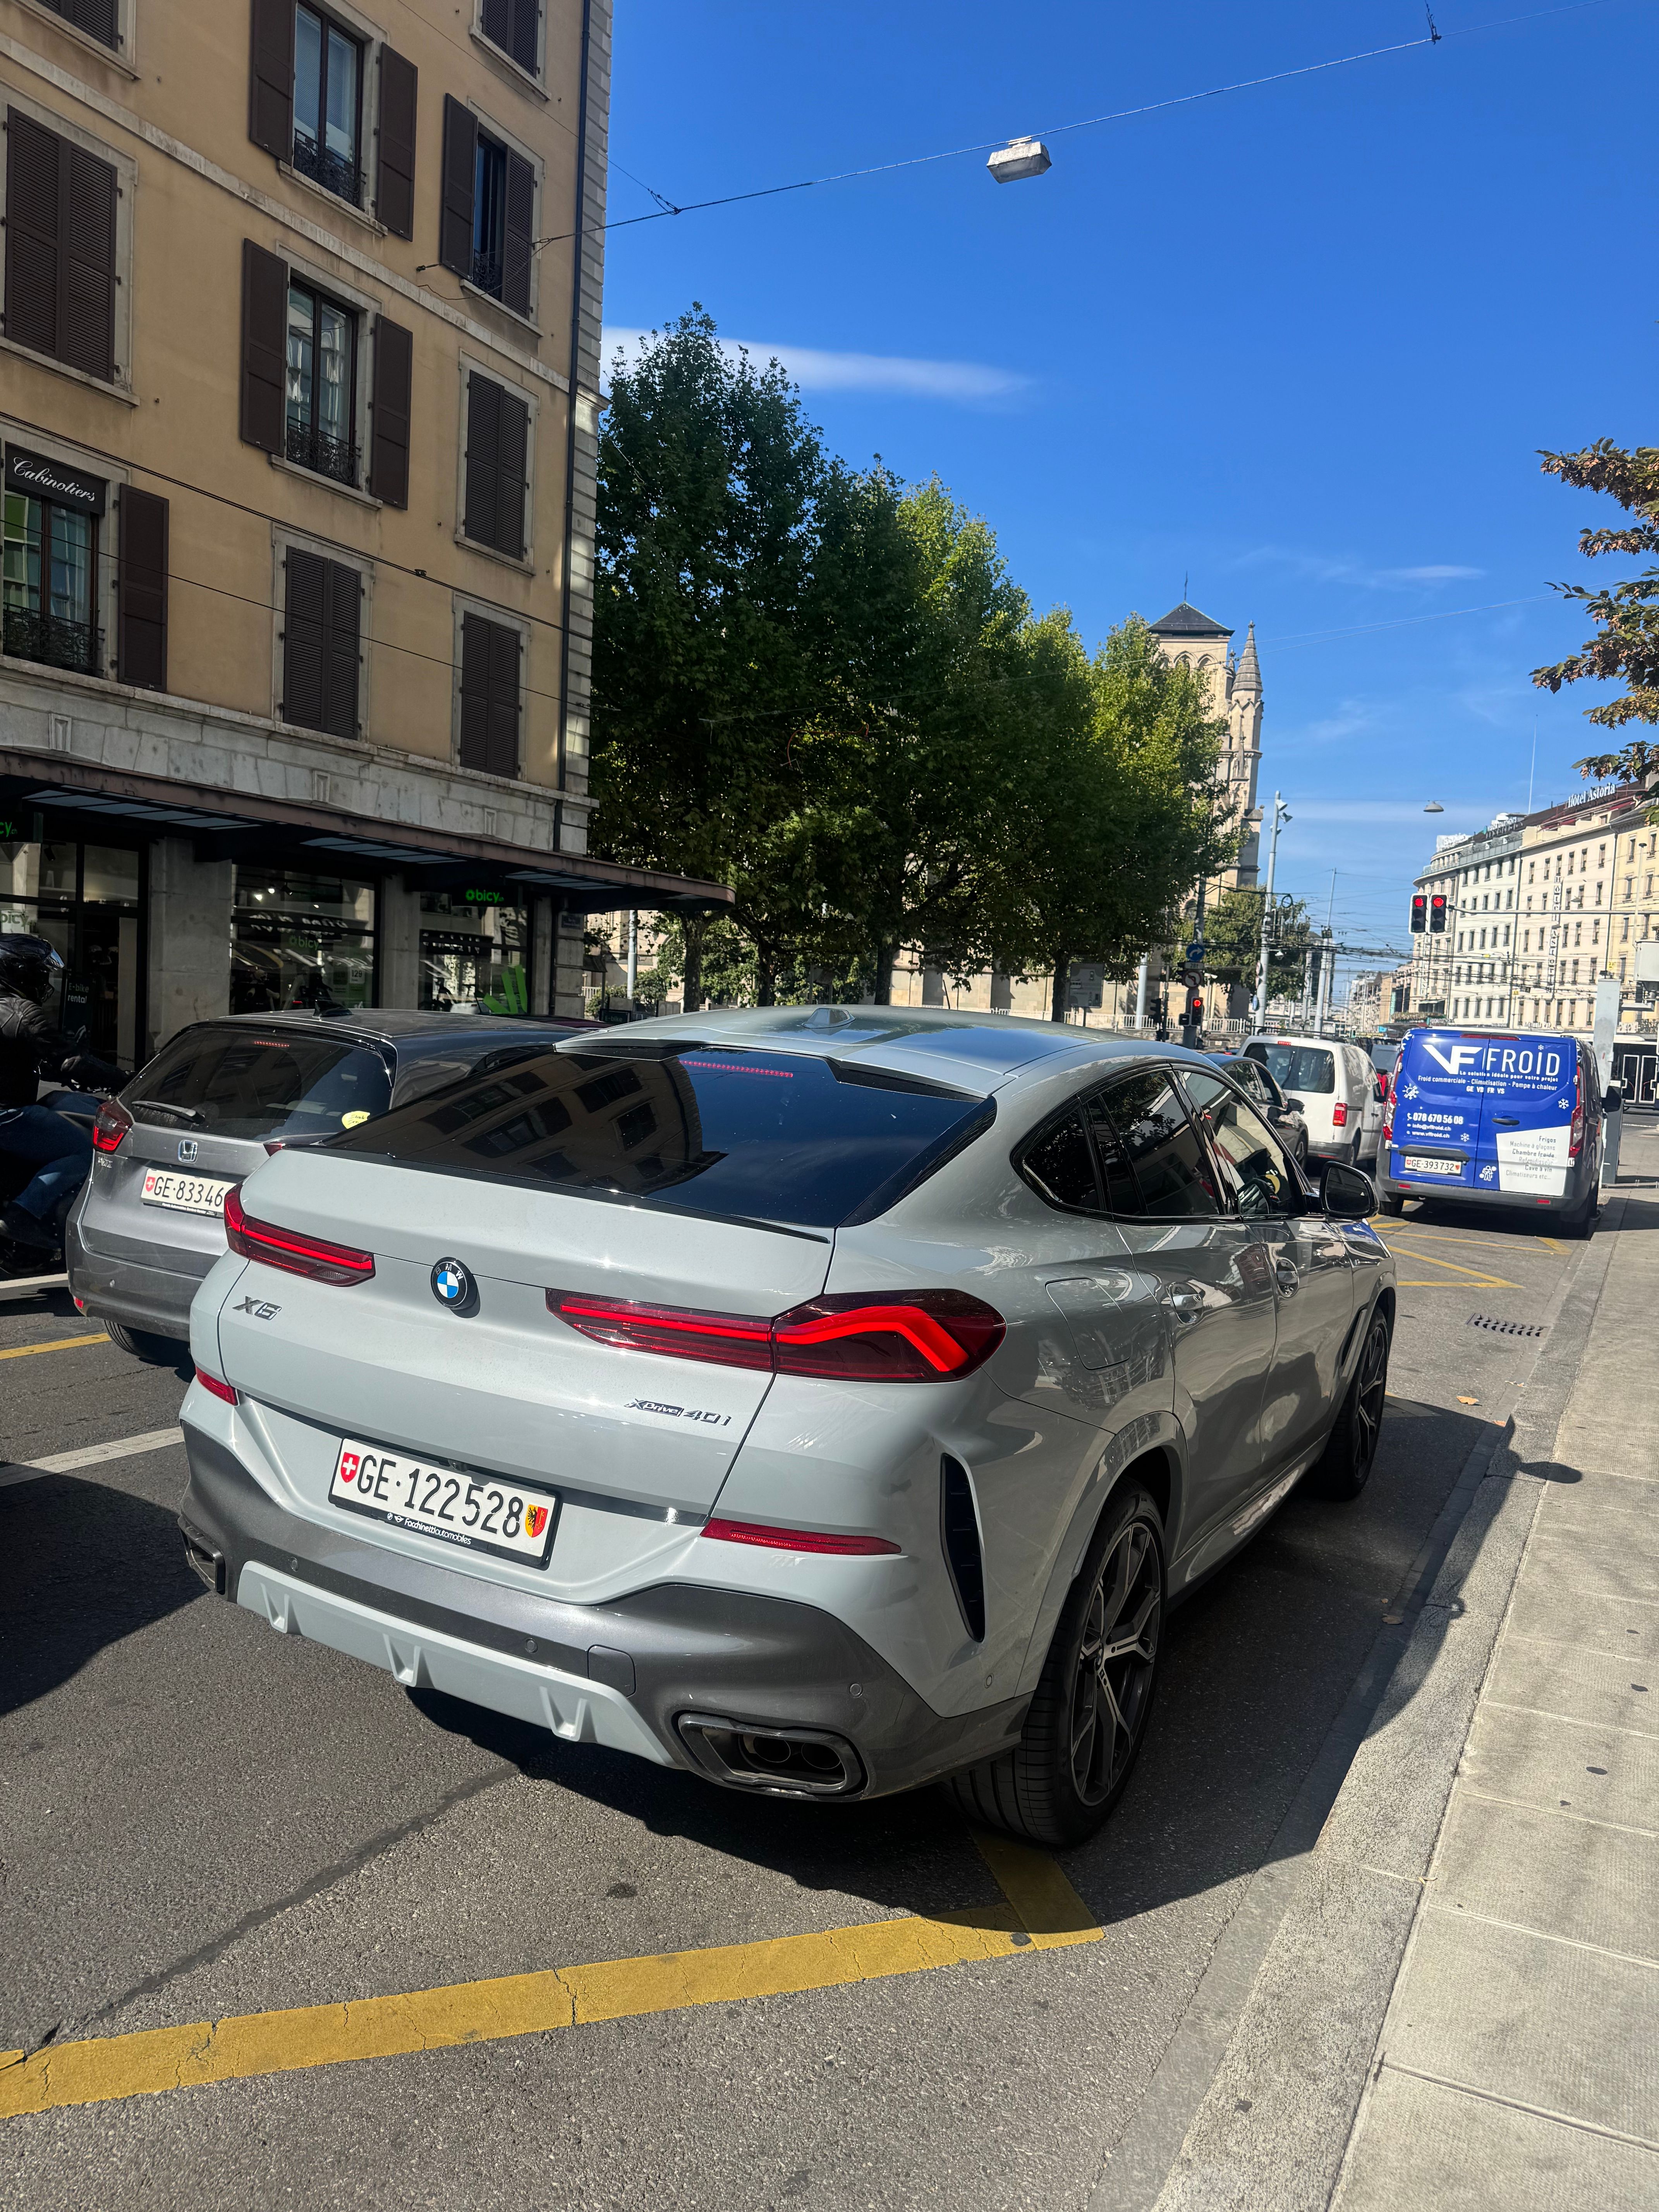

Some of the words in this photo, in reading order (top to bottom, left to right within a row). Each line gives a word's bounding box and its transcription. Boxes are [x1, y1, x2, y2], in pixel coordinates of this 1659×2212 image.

[14, 457, 95, 501] Cabinotiers
[69, 982, 89, 993] E-bike
[67, 994, 87, 1004] rental
[1422, 1044, 1483, 1075] VF
[1471, 1079, 1506, 1087] Climatisation
[1512, 1081, 1530, 1089] Pompe
[1413, 1112, 1427, 1122] 078
[1428, 1113, 1442, 1123] 670
[1443, 1115, 1452, 1124] 56
[1453, 1116, 1463, 1125] 08
[1512, 1148, 1537, 1156] Chambre
[1506, 1170, 1537, 1179] Climatiseurs
[232, 1296, 282, 1320] X6
